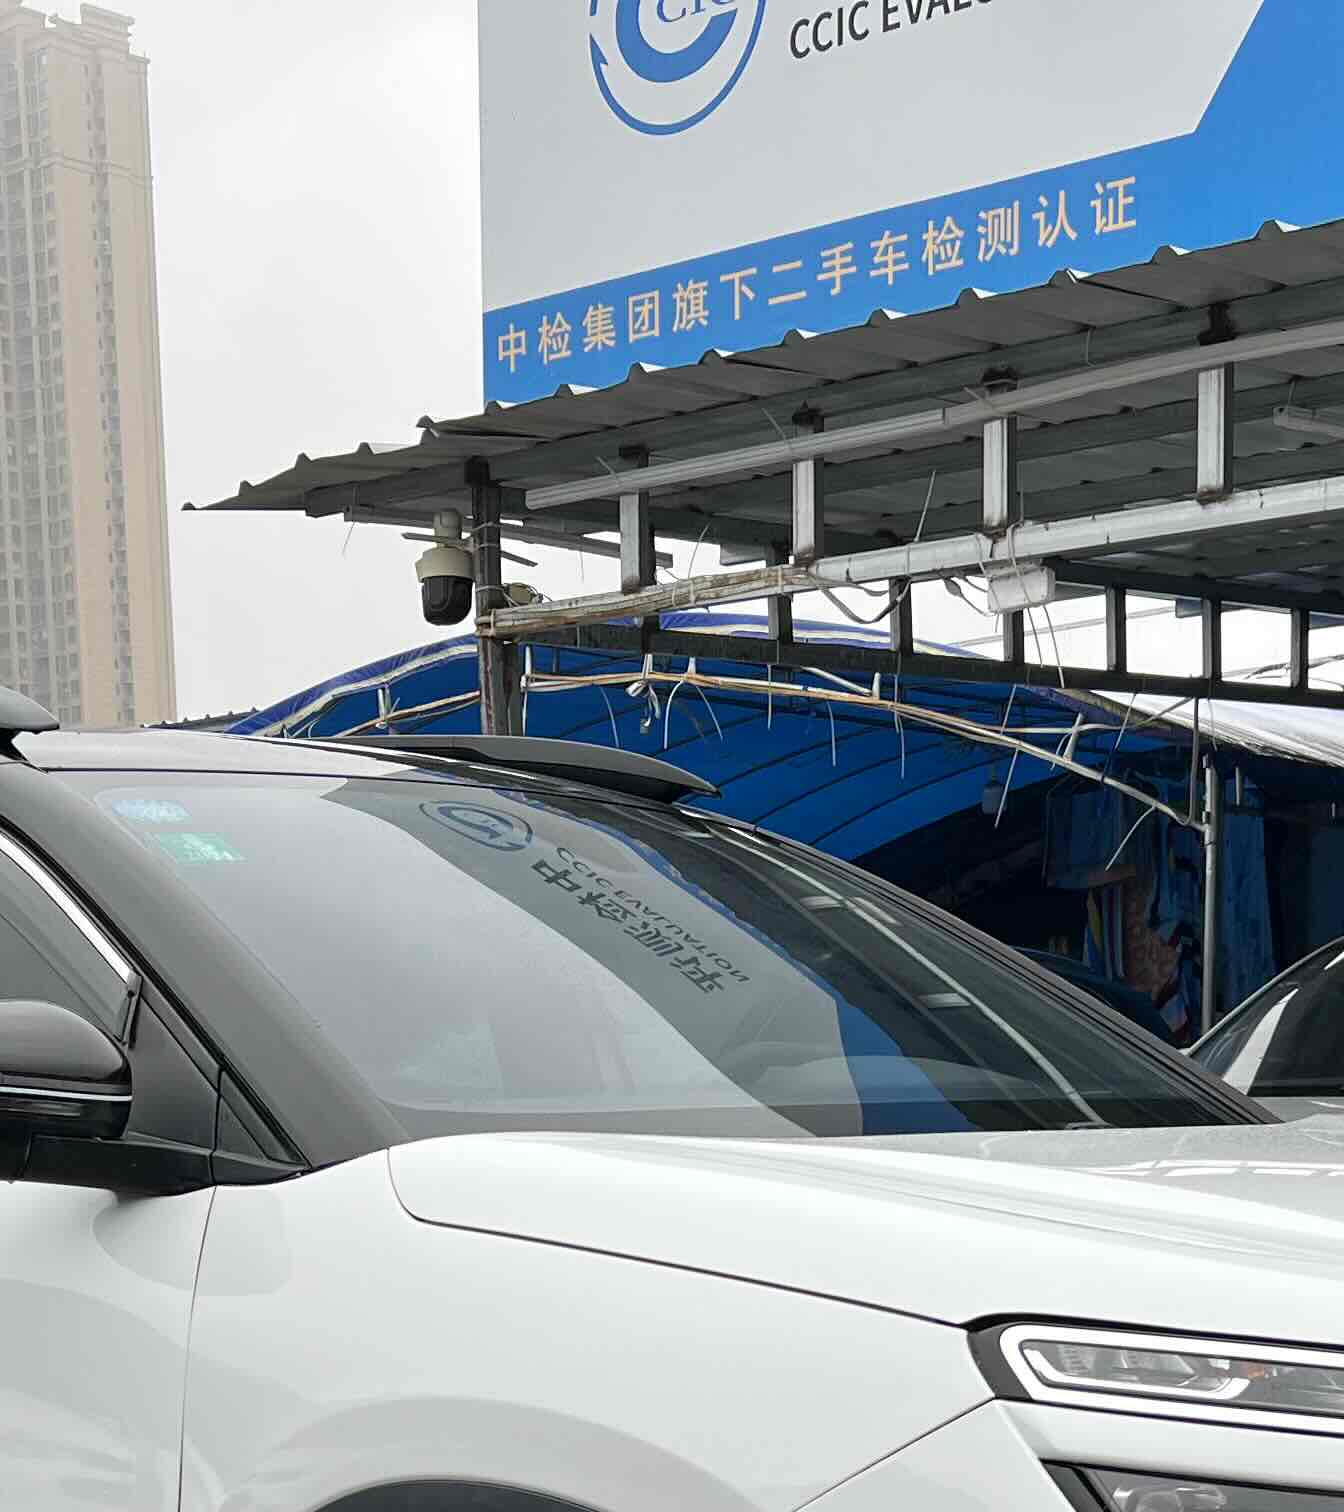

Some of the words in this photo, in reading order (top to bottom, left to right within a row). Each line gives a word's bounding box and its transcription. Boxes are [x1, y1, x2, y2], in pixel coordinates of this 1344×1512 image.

[789, 7, 870, 60] CCIC
[496, 176, 1137, 373] 中检集团旗下二手车检测认证
